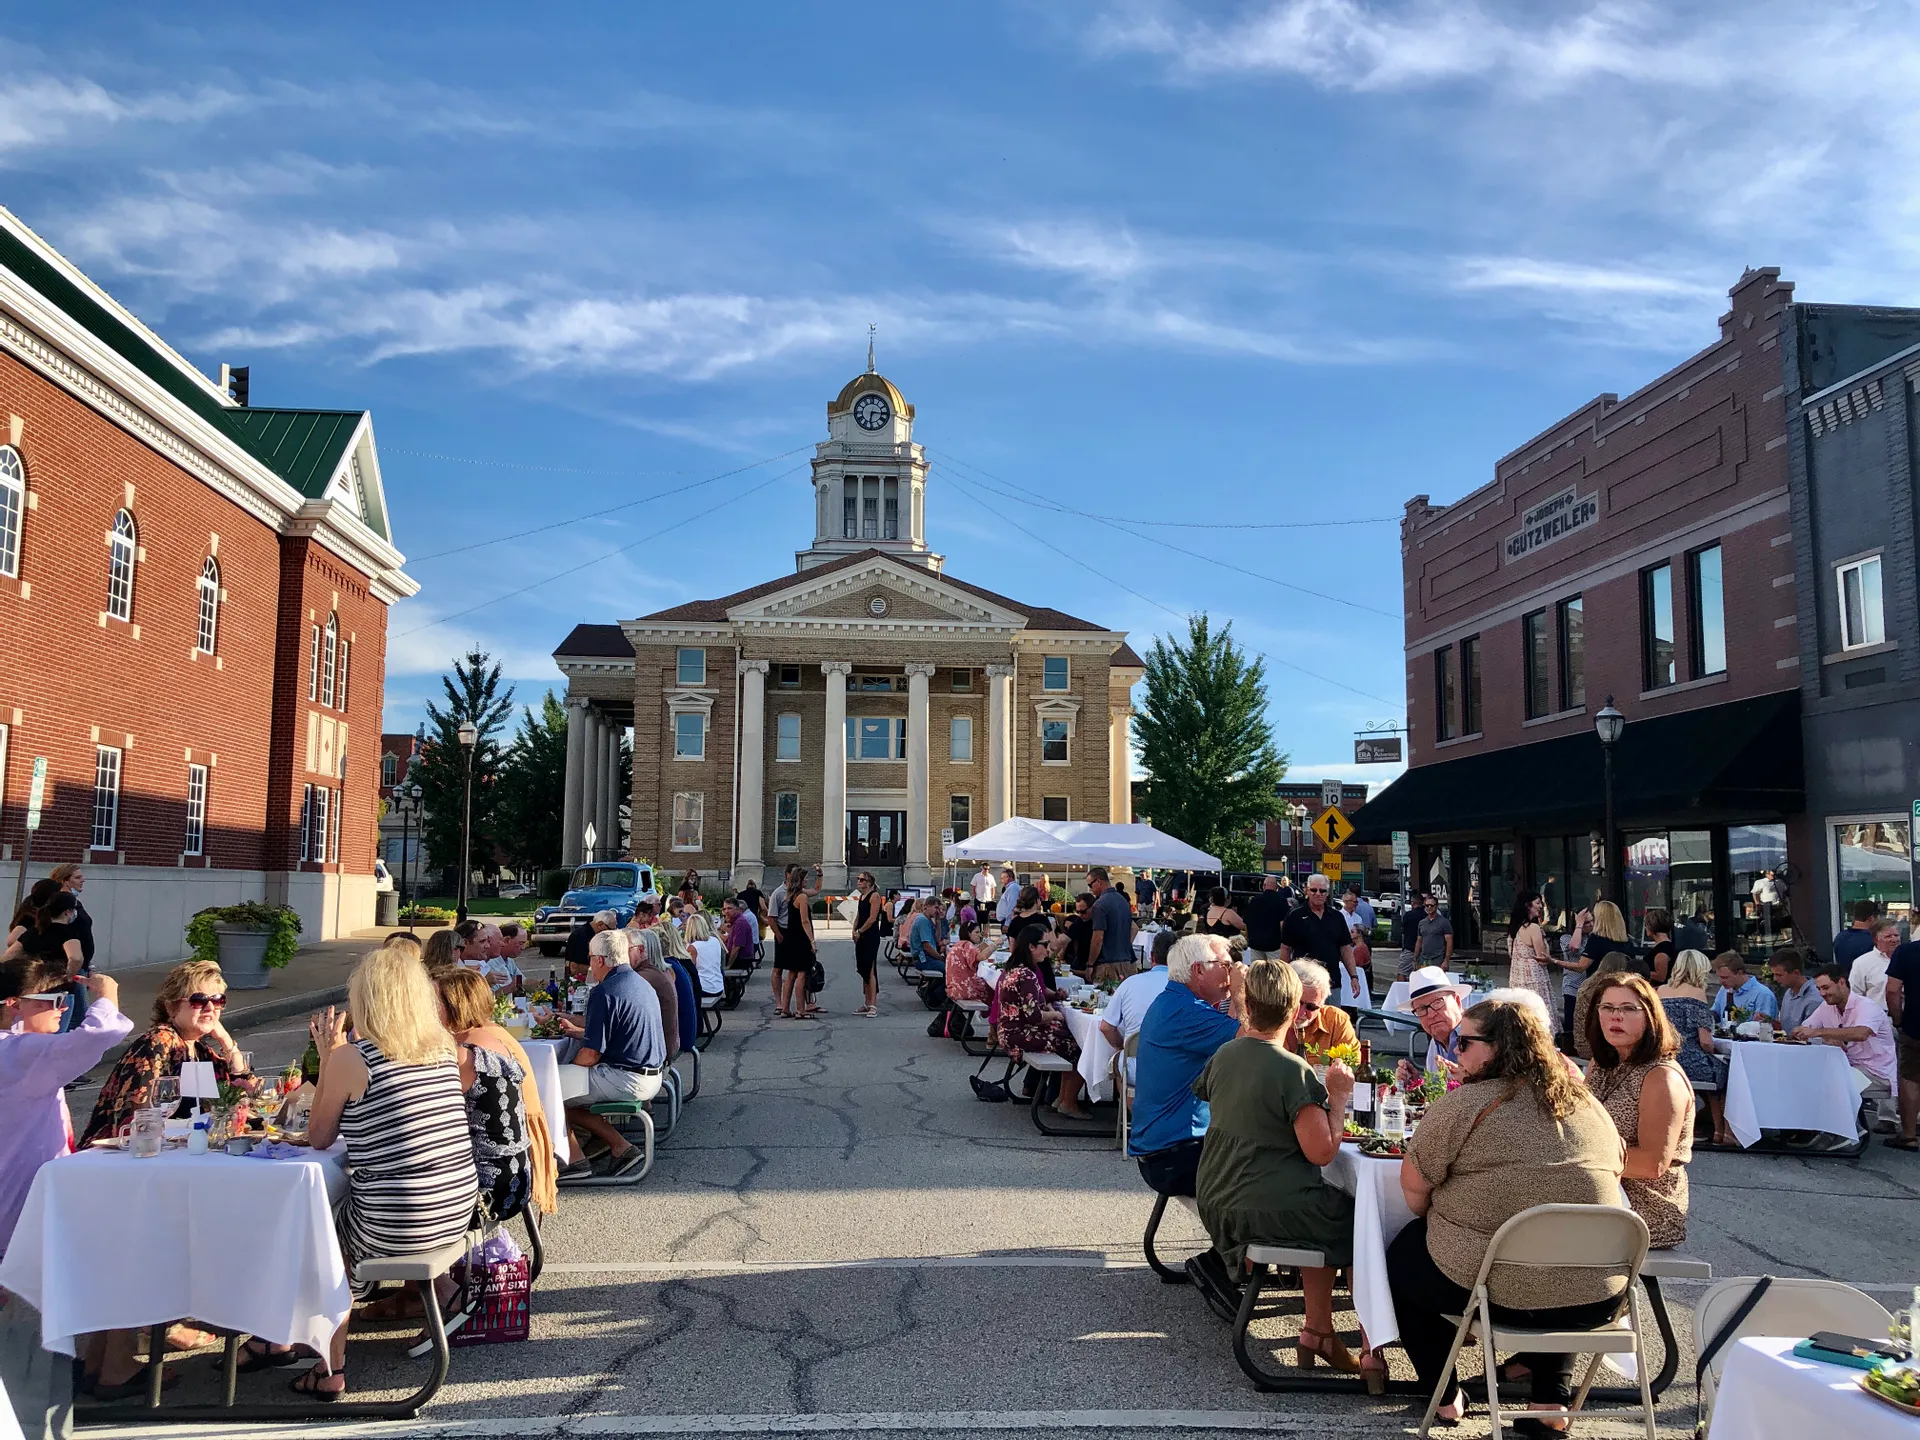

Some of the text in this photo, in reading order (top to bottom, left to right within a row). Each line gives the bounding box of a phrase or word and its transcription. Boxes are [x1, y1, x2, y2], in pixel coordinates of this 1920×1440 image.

[1534, 496, 1564, 522] JOSEPH
[1512, 502, 1589, 557] GUTZWEILER
[1325, 794, 1339, 804] 10
[1324, 862, 1341, 870] MERGE
[1431, 884, 1448, 899] ERA
[485, 1282, 505, 1292] ANY
[507, 1280, 527, 1290] SIX!
